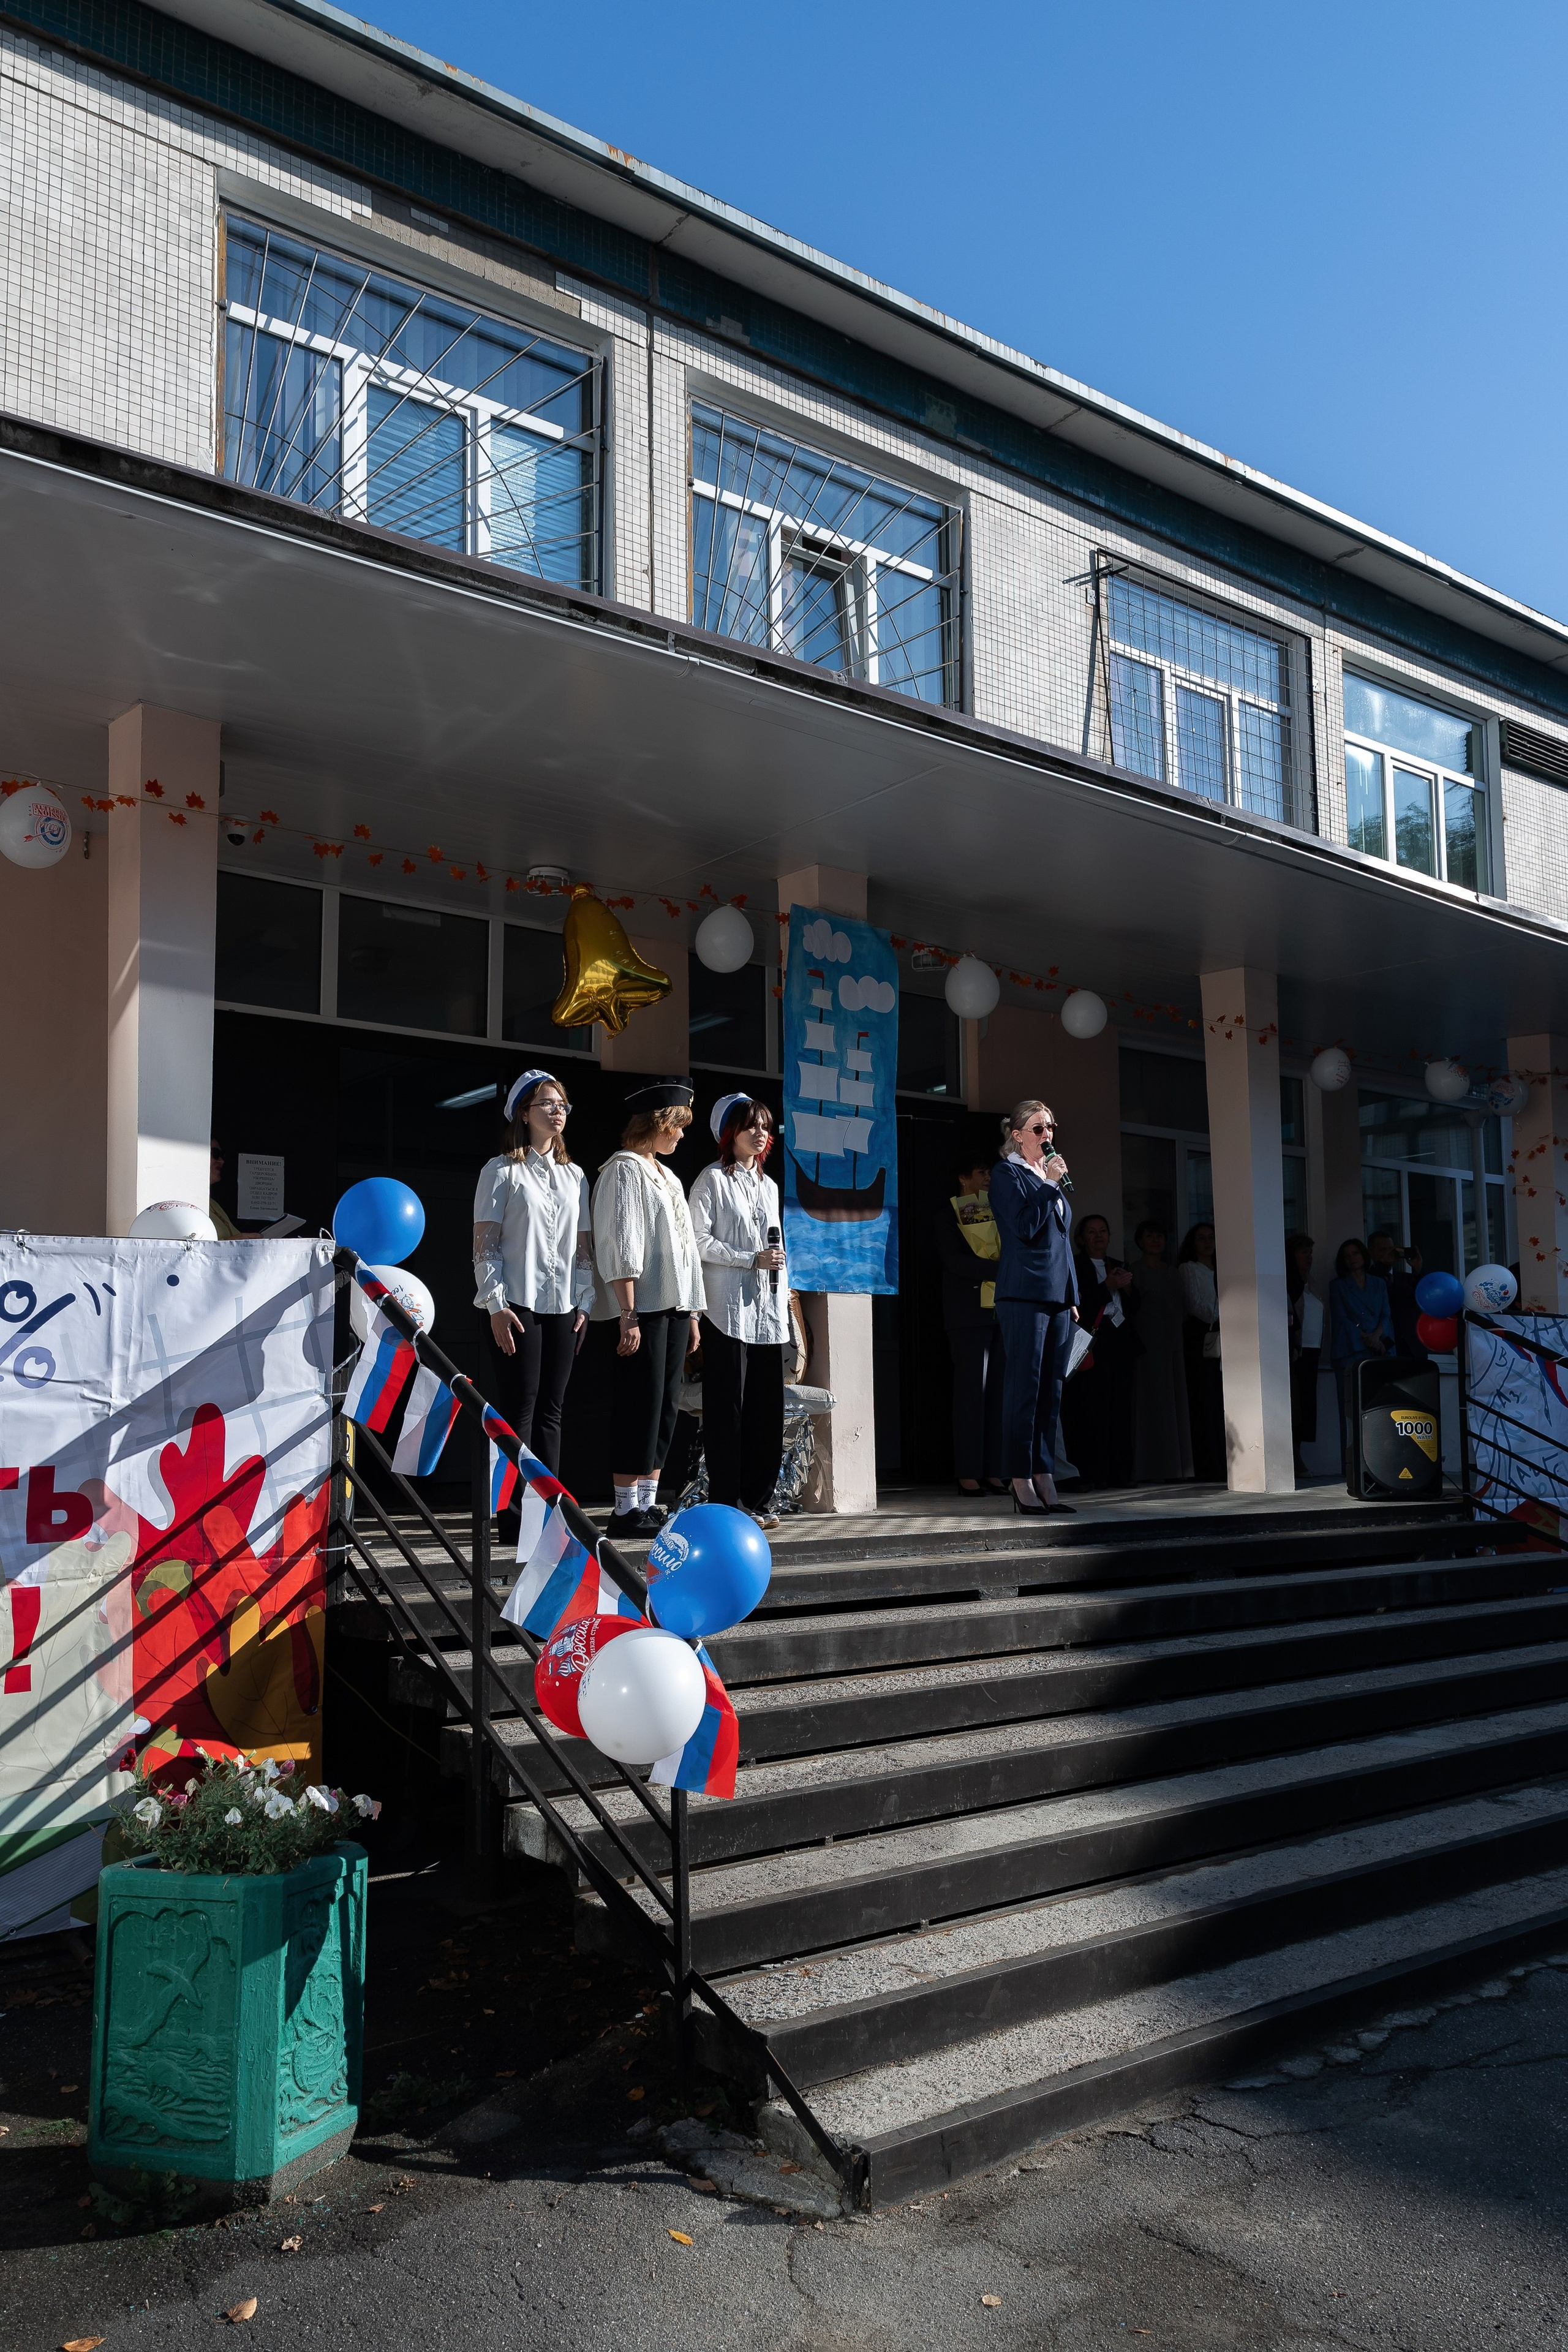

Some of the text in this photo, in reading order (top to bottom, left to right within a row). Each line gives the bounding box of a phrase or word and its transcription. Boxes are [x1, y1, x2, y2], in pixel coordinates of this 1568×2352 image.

[1395, 1421, 1433, 1436] 1000
[651, 1543, 682, 1571] ссию
[590, 1618, 602, 1636] страна
